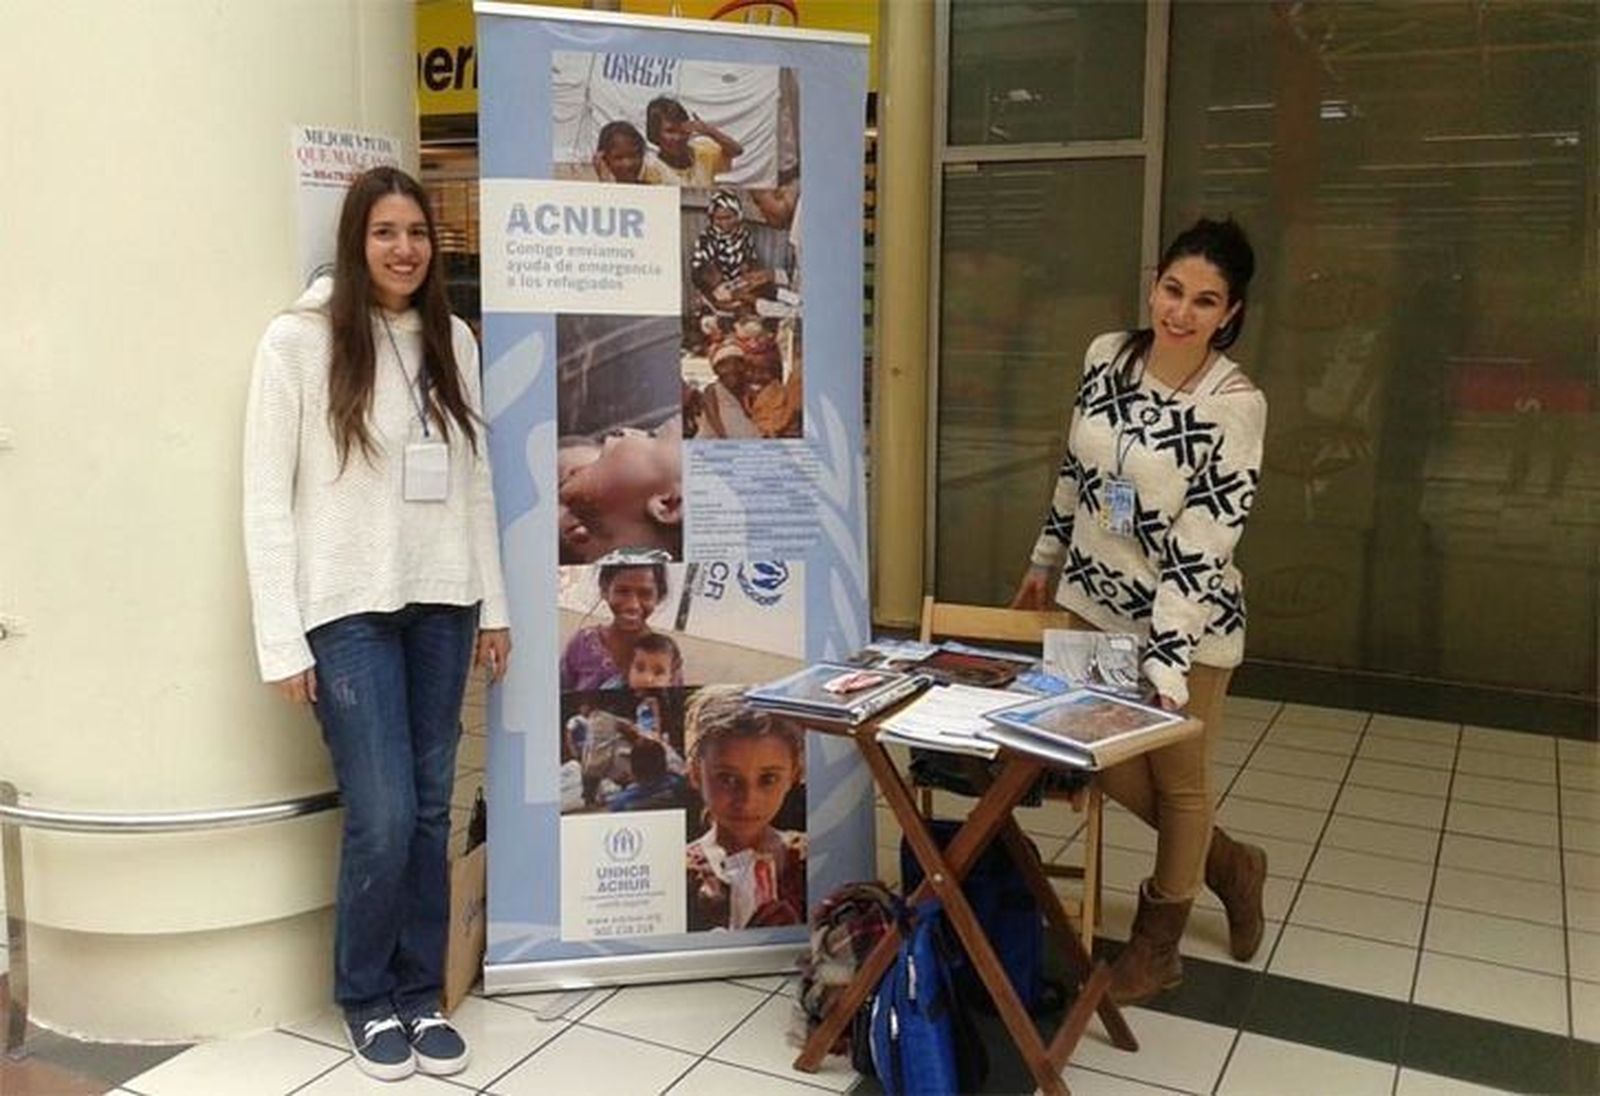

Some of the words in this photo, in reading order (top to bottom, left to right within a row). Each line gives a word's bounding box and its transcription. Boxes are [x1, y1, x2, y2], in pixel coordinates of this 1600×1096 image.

[417, 46, 478, 92] er
[506, 203, 645, 238] ACNUR
[506, 241, 563, 258] Contigo
[567, 244, 635, 259] enviamos
[507, 259, 550, 275] ayuda
[554, 260, 573, 272] de
[578, 261, 662, 279] emergencia
[507, 276, 516, 287] a
[520, 274, 542, 288] los
[546, 276, 625, 292] refugiados
[597, 878, 651, 893] ACNUR
